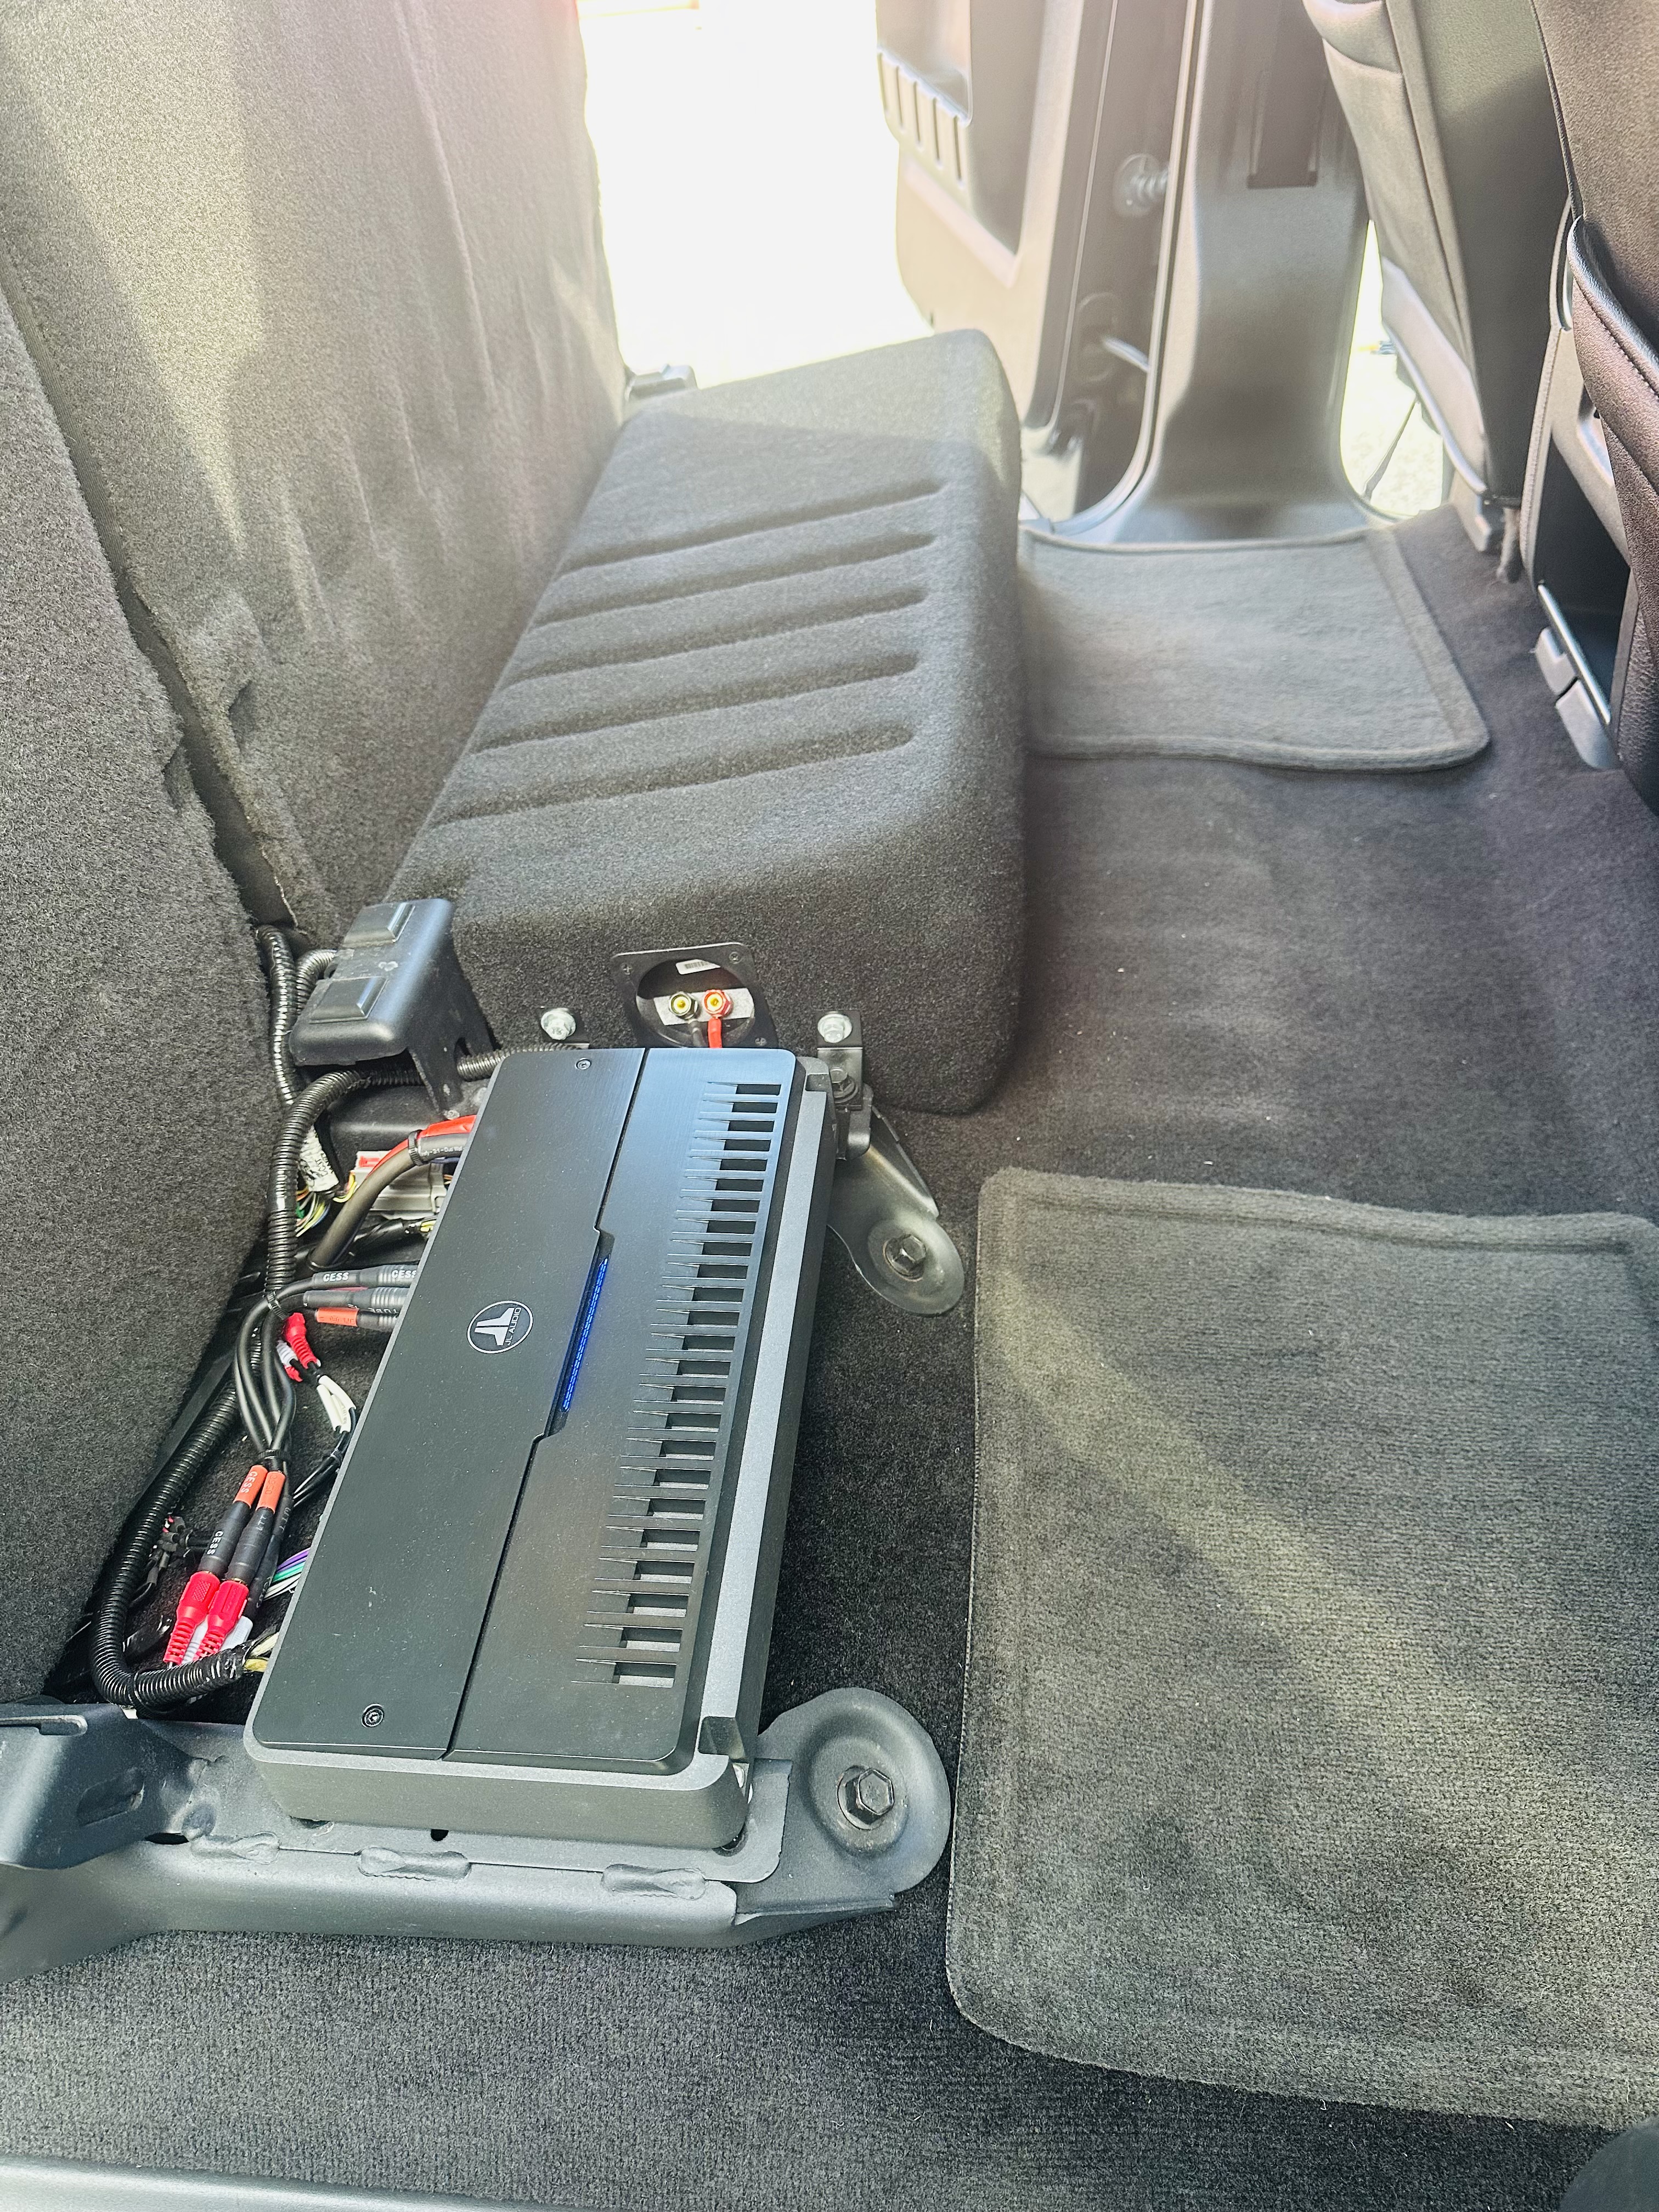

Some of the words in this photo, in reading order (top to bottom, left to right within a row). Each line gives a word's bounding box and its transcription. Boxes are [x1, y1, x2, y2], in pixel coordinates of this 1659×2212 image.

[323, 1272, 349, 1282] CESS
[508, 1307, 522, 1334] AUDIO
[505, 1334, 513, 1346] JL
[240, 1471, 258, 1493] CESS
[206, 1531, 224, 1555] CESS
